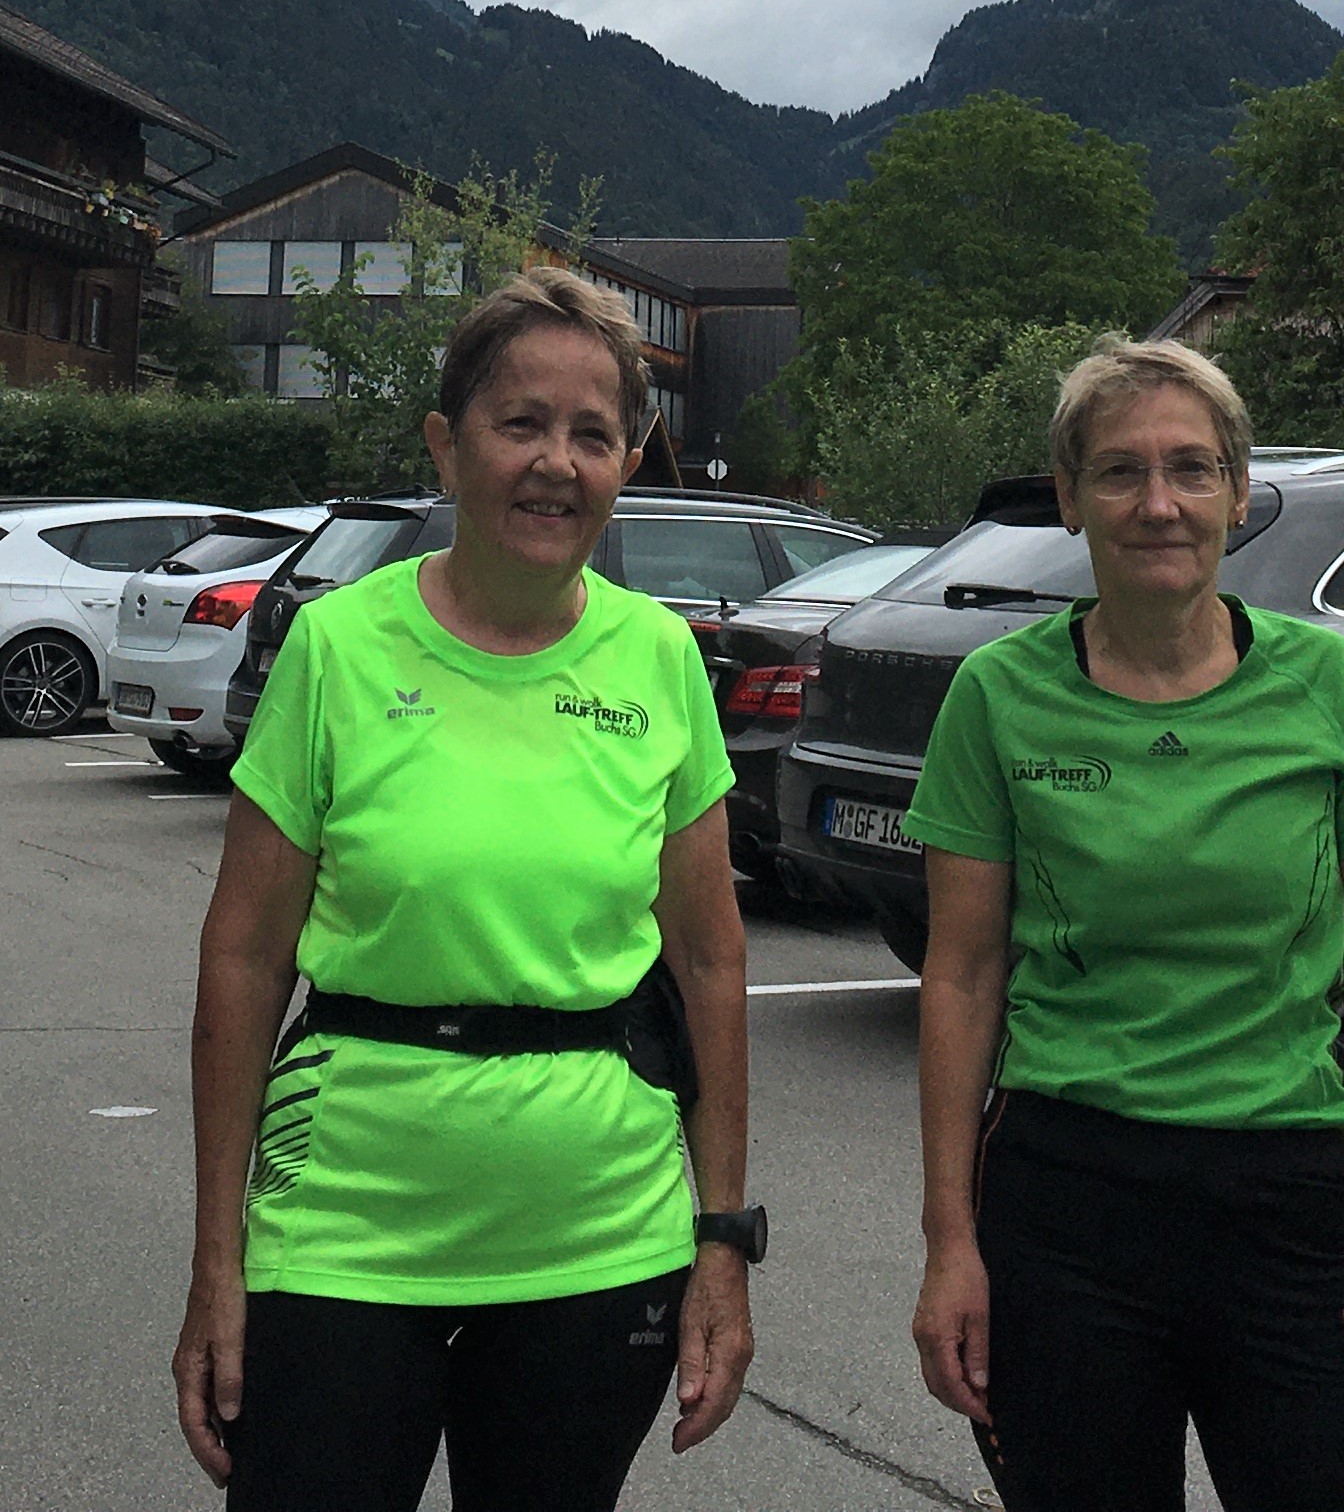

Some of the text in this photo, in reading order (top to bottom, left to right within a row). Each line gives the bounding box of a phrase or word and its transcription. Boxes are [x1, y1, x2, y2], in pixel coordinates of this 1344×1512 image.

[844, 649, 954, 670] PORSCHE
[555, 693, 571, 702] run
[387, 705, 436, 720] erima
[555, 701, 634, 726] LAUF-TREFF
[594, 720, 637, 739] Buchs SG
[1147, 745, 1189, 757] adidas
[1012, 768, 1092, 781] LAUF-TREFF
[1081, 780, 1097, 792] SG
[832, 804, 846, 835] M
[854, 807, 879, 840] GF
[629, 1329, 664, 1345] erima
